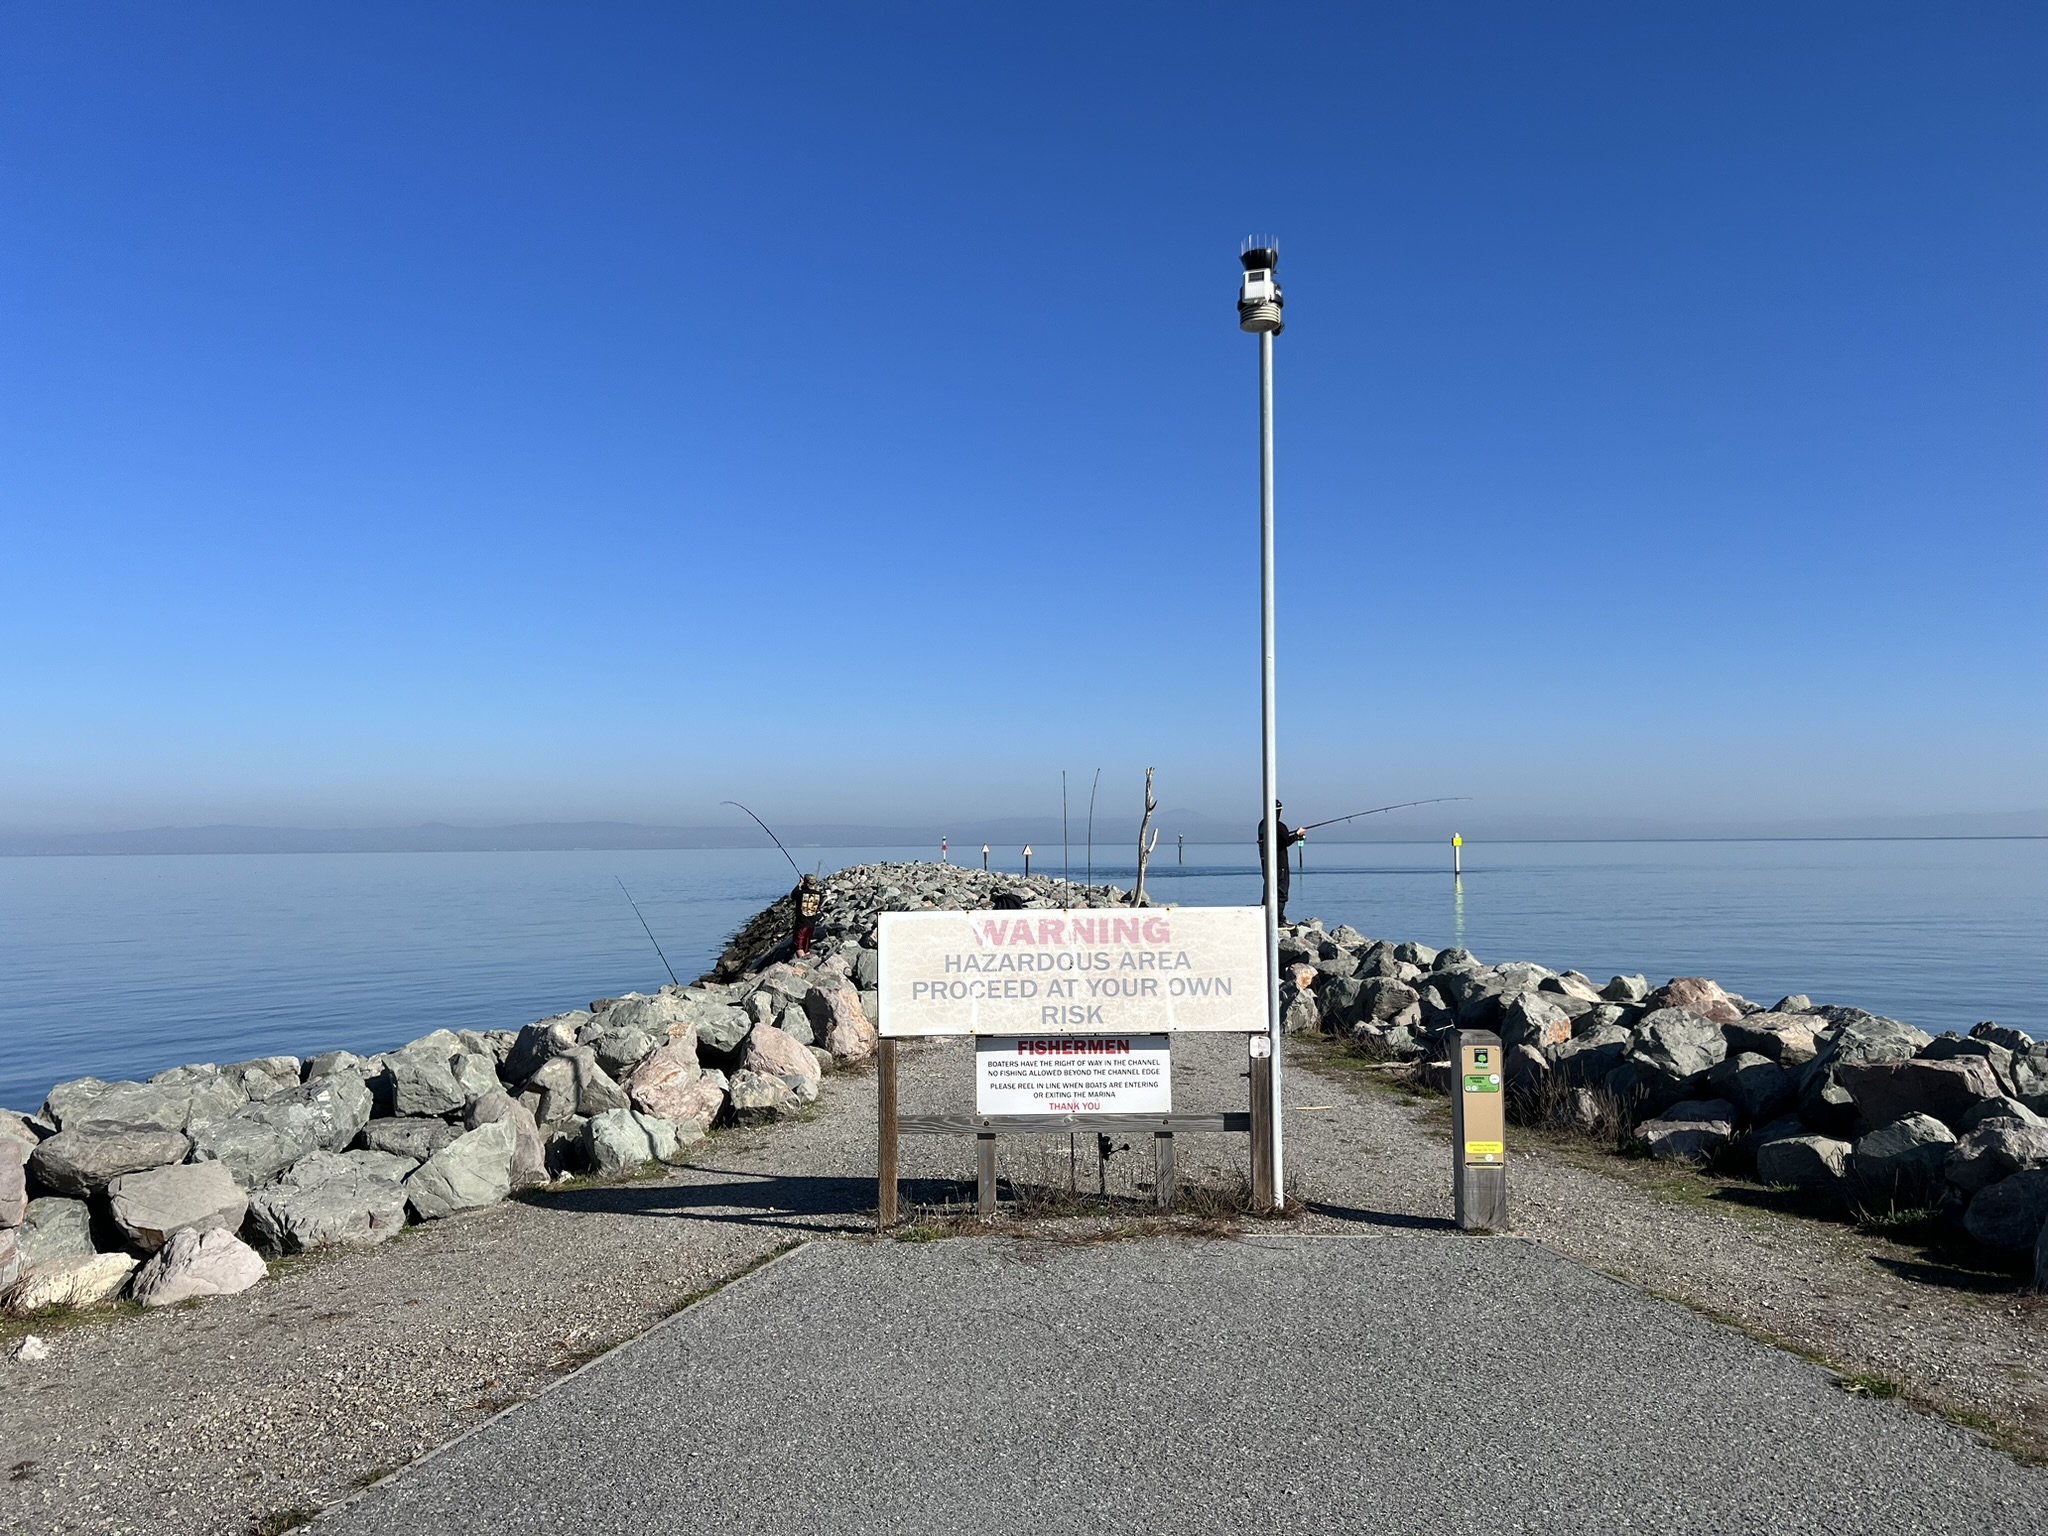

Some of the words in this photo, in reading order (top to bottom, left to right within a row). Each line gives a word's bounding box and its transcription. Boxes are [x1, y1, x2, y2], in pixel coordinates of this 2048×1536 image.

[974, 916, 1170, 946] WARNING
[945, 952, 1110, 972] HAZARDOUS
[1119, 951, 1191, 970] AREA
[913, 980, 1038, 999] PROCEED
[1047, 979, 1078, 997] AT
[1086, 978, 1157, 997] YOUR
[1169, 977, 1232, 996] OWN
[1042, 1005, 1104, 1024] RISK
[1018, 1040, 1129, 1055] FISHERMEN
